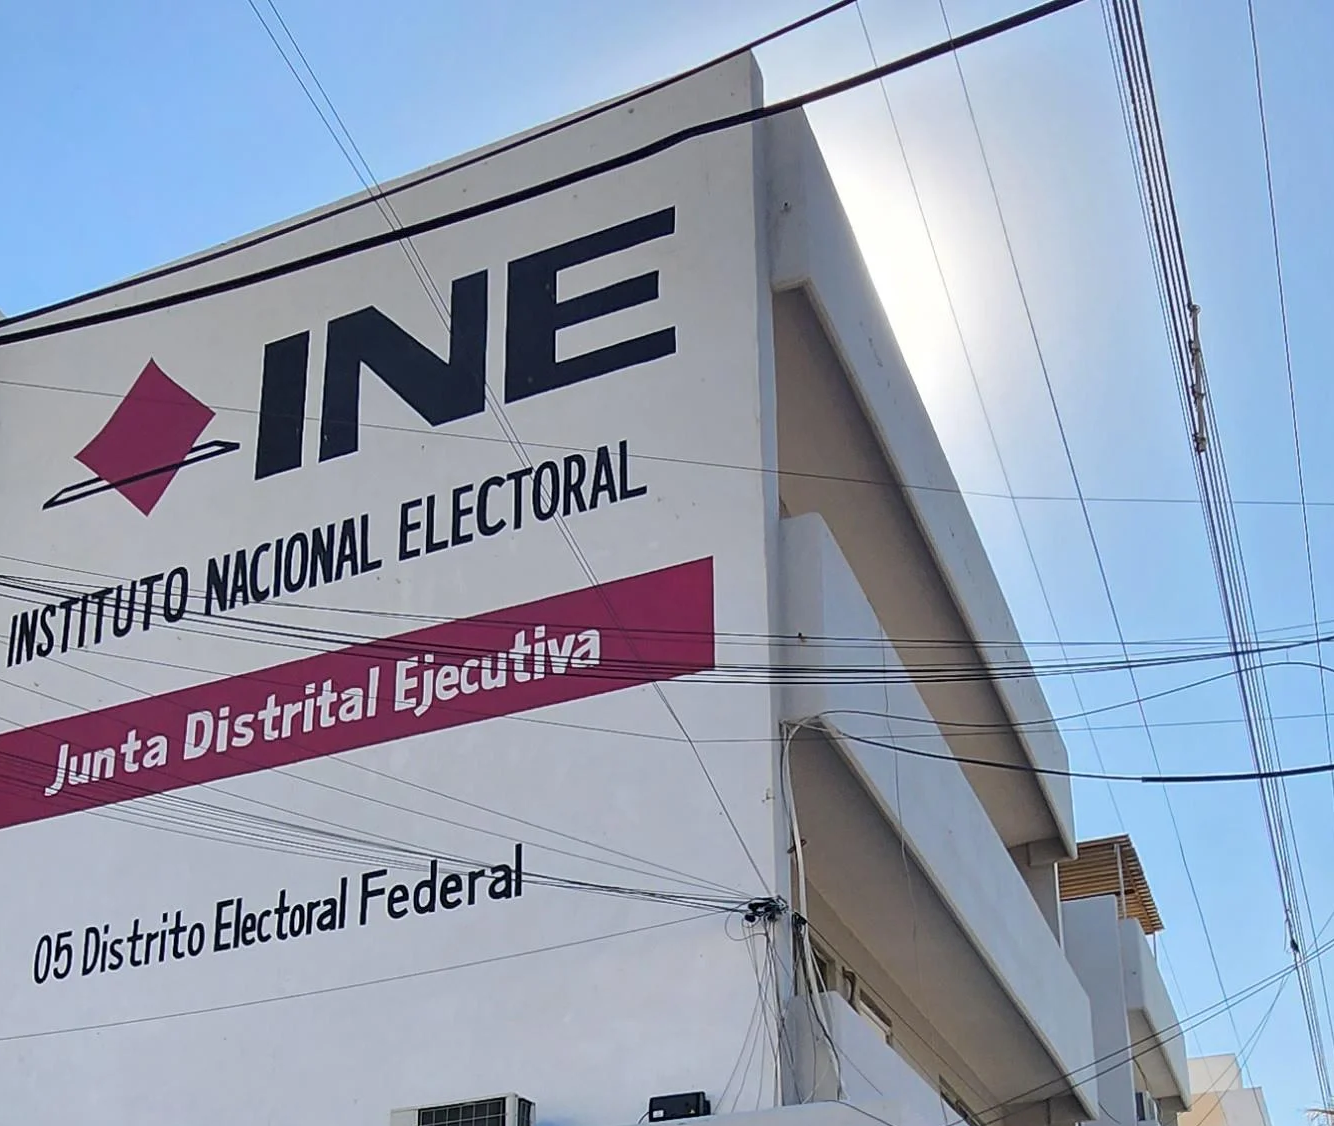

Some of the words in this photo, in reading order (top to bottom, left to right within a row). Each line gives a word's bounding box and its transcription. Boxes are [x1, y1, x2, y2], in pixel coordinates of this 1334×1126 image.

[254, 205, 676, 481] INE
[6, 566, 188, 667] INSTITUTO
[203, 521, 383, 617] NACIONAL
[398, 440, 647, 563] ELECTORAL
[44, 728, 169, 798] Junta
[183, 667, 379, 760] Distrital
[393, 623, 602, 717] Ejecutiva
[33, 933, 72, 985] 05
[81, 905, 205, 980] Distrito
[212, 876, 347, 953] Electoral
[359, 843, 524, 926] Federal
